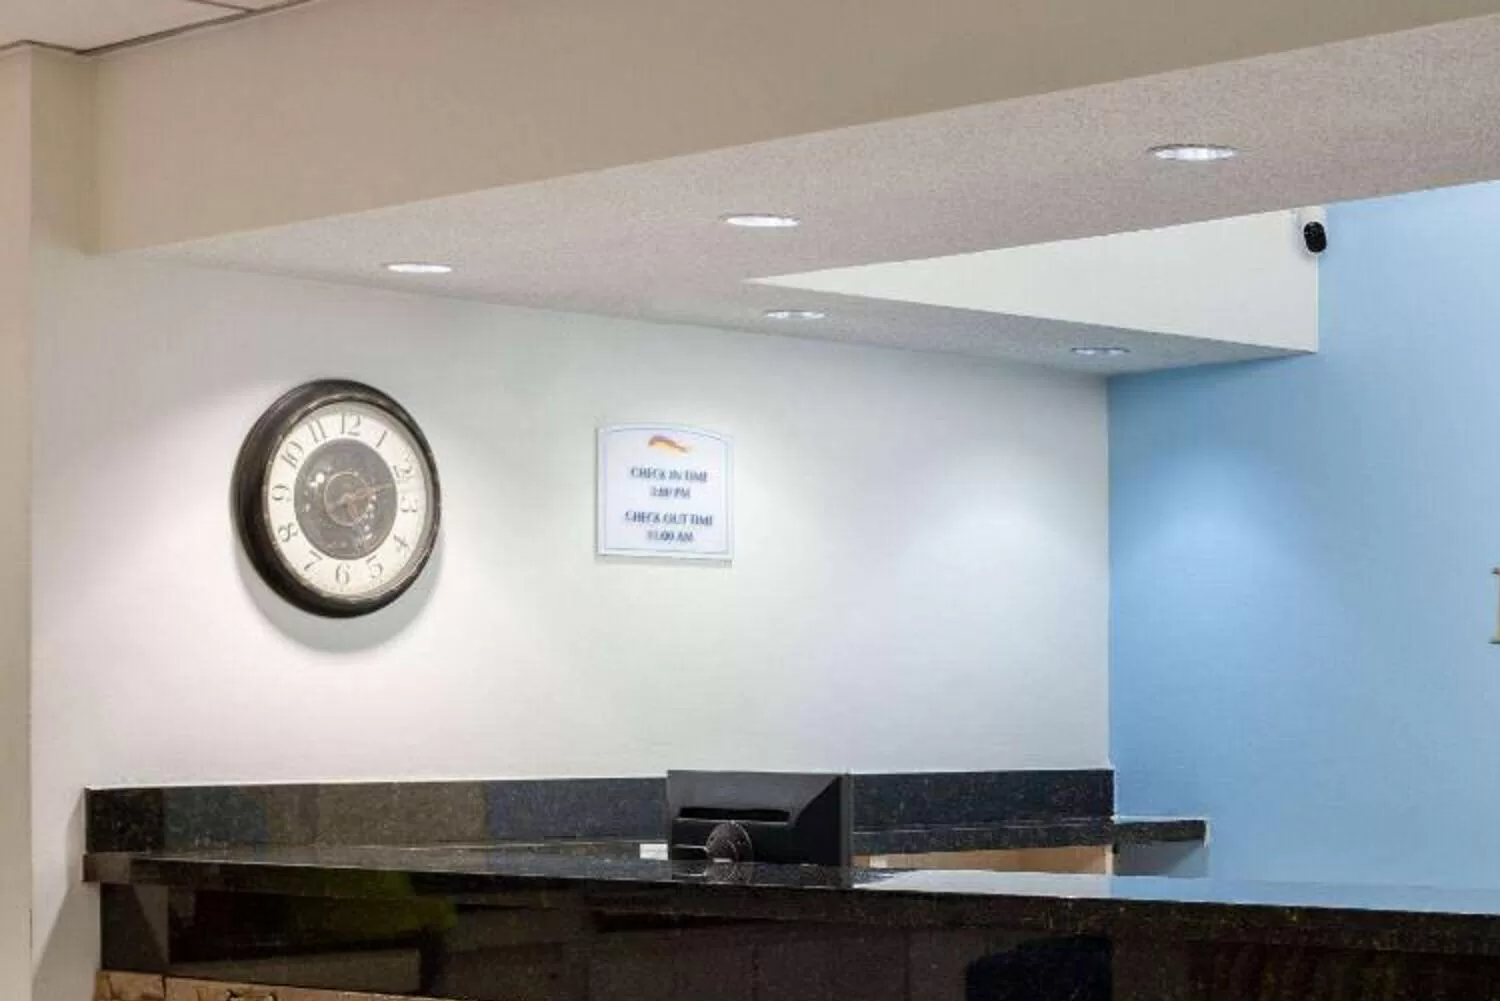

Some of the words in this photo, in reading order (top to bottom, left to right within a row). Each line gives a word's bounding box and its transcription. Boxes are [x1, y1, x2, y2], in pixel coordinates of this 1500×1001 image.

[308, 419, 329, 444] 11
[340, 413, 362, 437] 12
[375, 429, 389, 449] 1
[281, 440, 305, 468] 10
[392, 456, 413, 478] 2
[630, 466, 665, 481] CHECK
[669, 470, 682, 481] IN
[685, 469, 708, 483] TIME
[271, 484, 292, 502] 9
[674, 487, 691, 499] PM
[400, 495, 418, 513] 3
[624, 510, 661, 524] CHECK
[663, 513, 687, 525] OUT
[689, 514, 713, 526] TIME
[277, 522, 299, 543] 8
[676, 531, 694, 542] AM
[303, 548, 323, 572] 7
[365, 554, 384, 579] 5
[335, 563, 351, 585] 6
